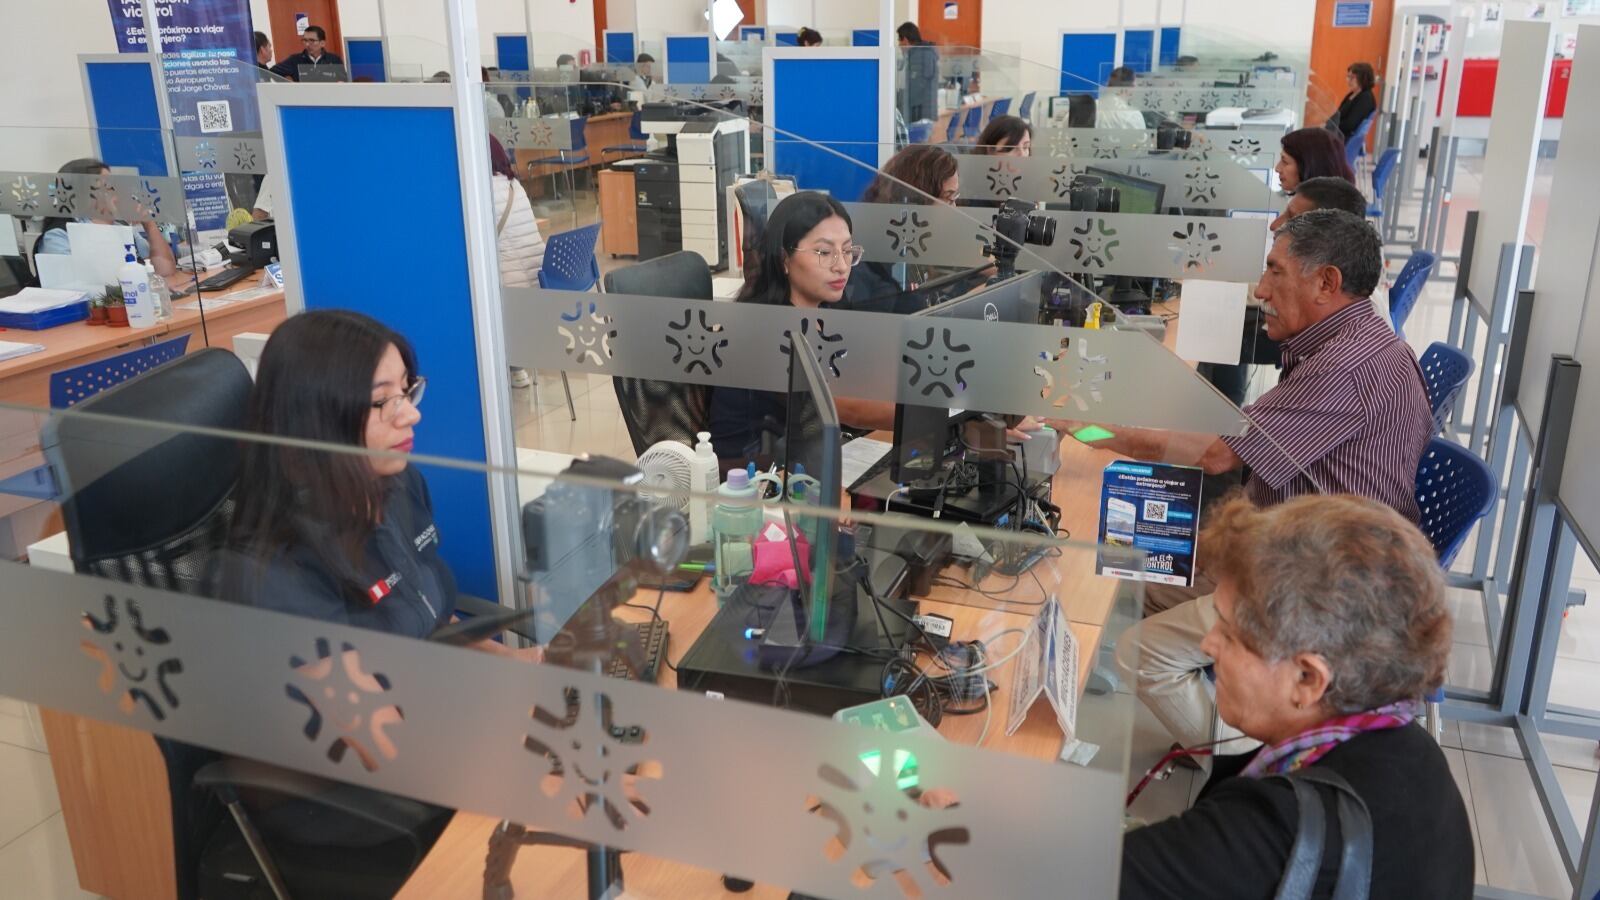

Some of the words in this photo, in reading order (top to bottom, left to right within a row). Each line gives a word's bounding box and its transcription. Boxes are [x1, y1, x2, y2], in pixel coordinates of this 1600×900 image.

[201, 25, 224, 34] viajar
[128, 36, 136, 44] al
[182, 85, 202, 93] Jorge
